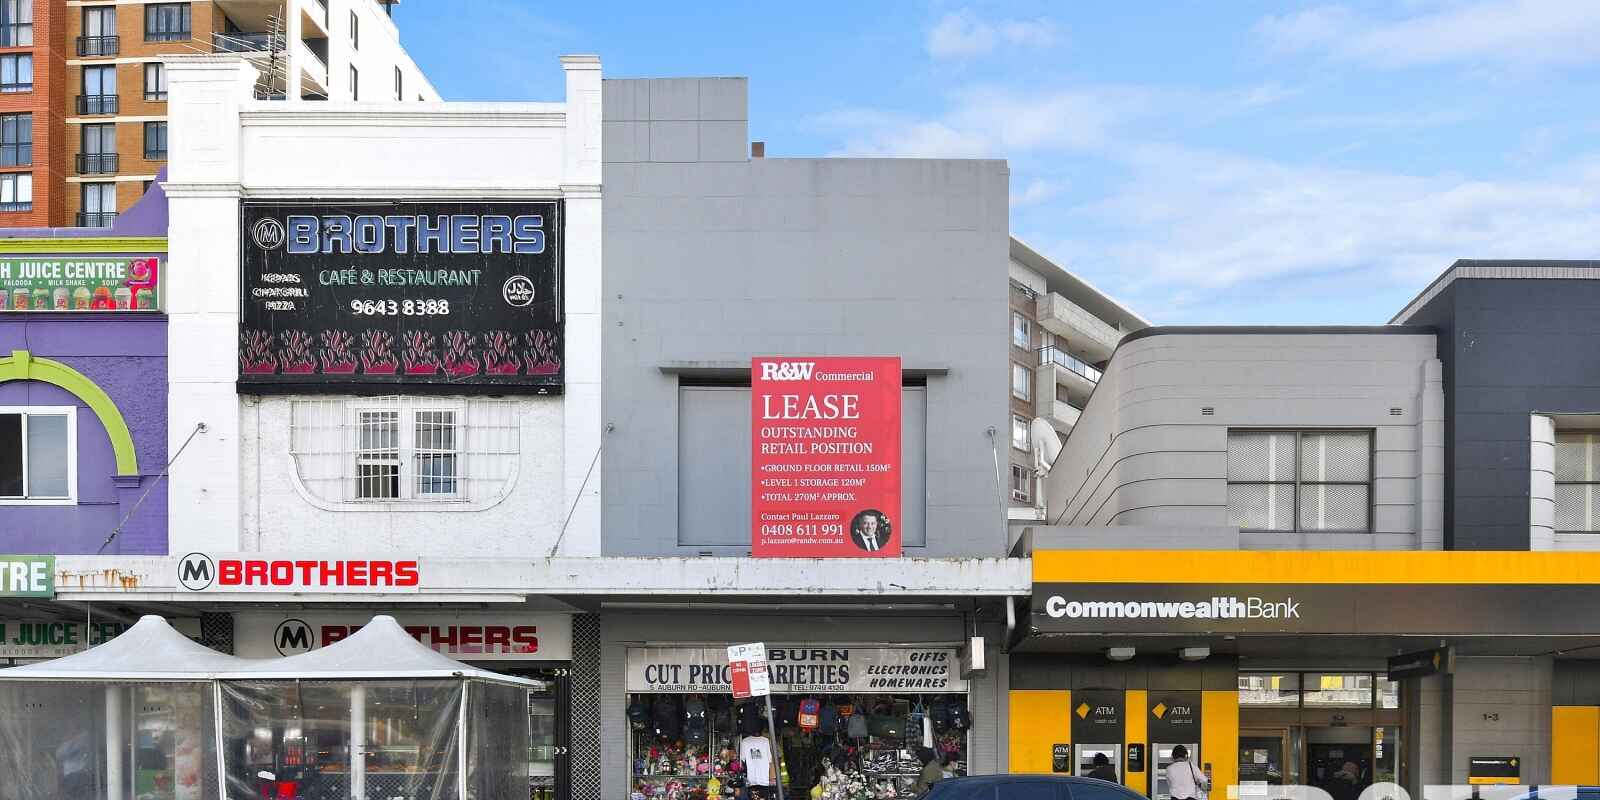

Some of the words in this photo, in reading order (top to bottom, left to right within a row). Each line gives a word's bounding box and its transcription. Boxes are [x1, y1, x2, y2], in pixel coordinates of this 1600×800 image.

[286, 215, 546, 254] BROTHERS
[18, 262, 61, 279] JUICE
[64, 262, 125, 279] CENTRE
[319, 266, 357, 287] CAFÉ
[360, 270, 374, 286] &
[378, 270, 481, 287] RESTAURANT
[351, 300, 397, 316] 9643
[402, 300, 449, 316] 8388
[761, 362, 815, 381] R&W
[815, 371, 874, 381] Commercial
[762, 394, 860, 420] LEASE
[761, 427, 858, 439] OUTSTANDING
[761, 443, 807, 454] RETAIL
[811, 443, 873, 454] POSITION
[804, 464, 832, 472] FLOOR
[834, 464, 864, 472] RETAIL
[800, 478, 840, 487] STORAGE
[761, 512, 790, 521] Contact
[792, 512, 809, 521] Paul
[811, 512, 840, 521] Lazzaro
[761, 524, 793, 536] 0408
[796, 524, 818, 536] 611
[822, 524, 844, 536] 991
[183, 560, 210, 581] M
[218, 560, 419, 586] BROTHERS
[1046, 595, 1300, 618] CommonwealthBank
[13, 623, 77, 646] JUICE
[280, 627, 307, 648] M
[910, 652, 947, 662] GIFTS
[645, 664, 681, 684] CUT
[689, 664, 731, 684] PRIC
[867, 665, 948, 675] ELECTRONICS
[870, 678, 948, 688] HOMEWARES
[1095, 706, 1115, 715] ATM
[1171, 706, 1191, 715] ATM
[1482, 713, 1499, 721] 1-3
